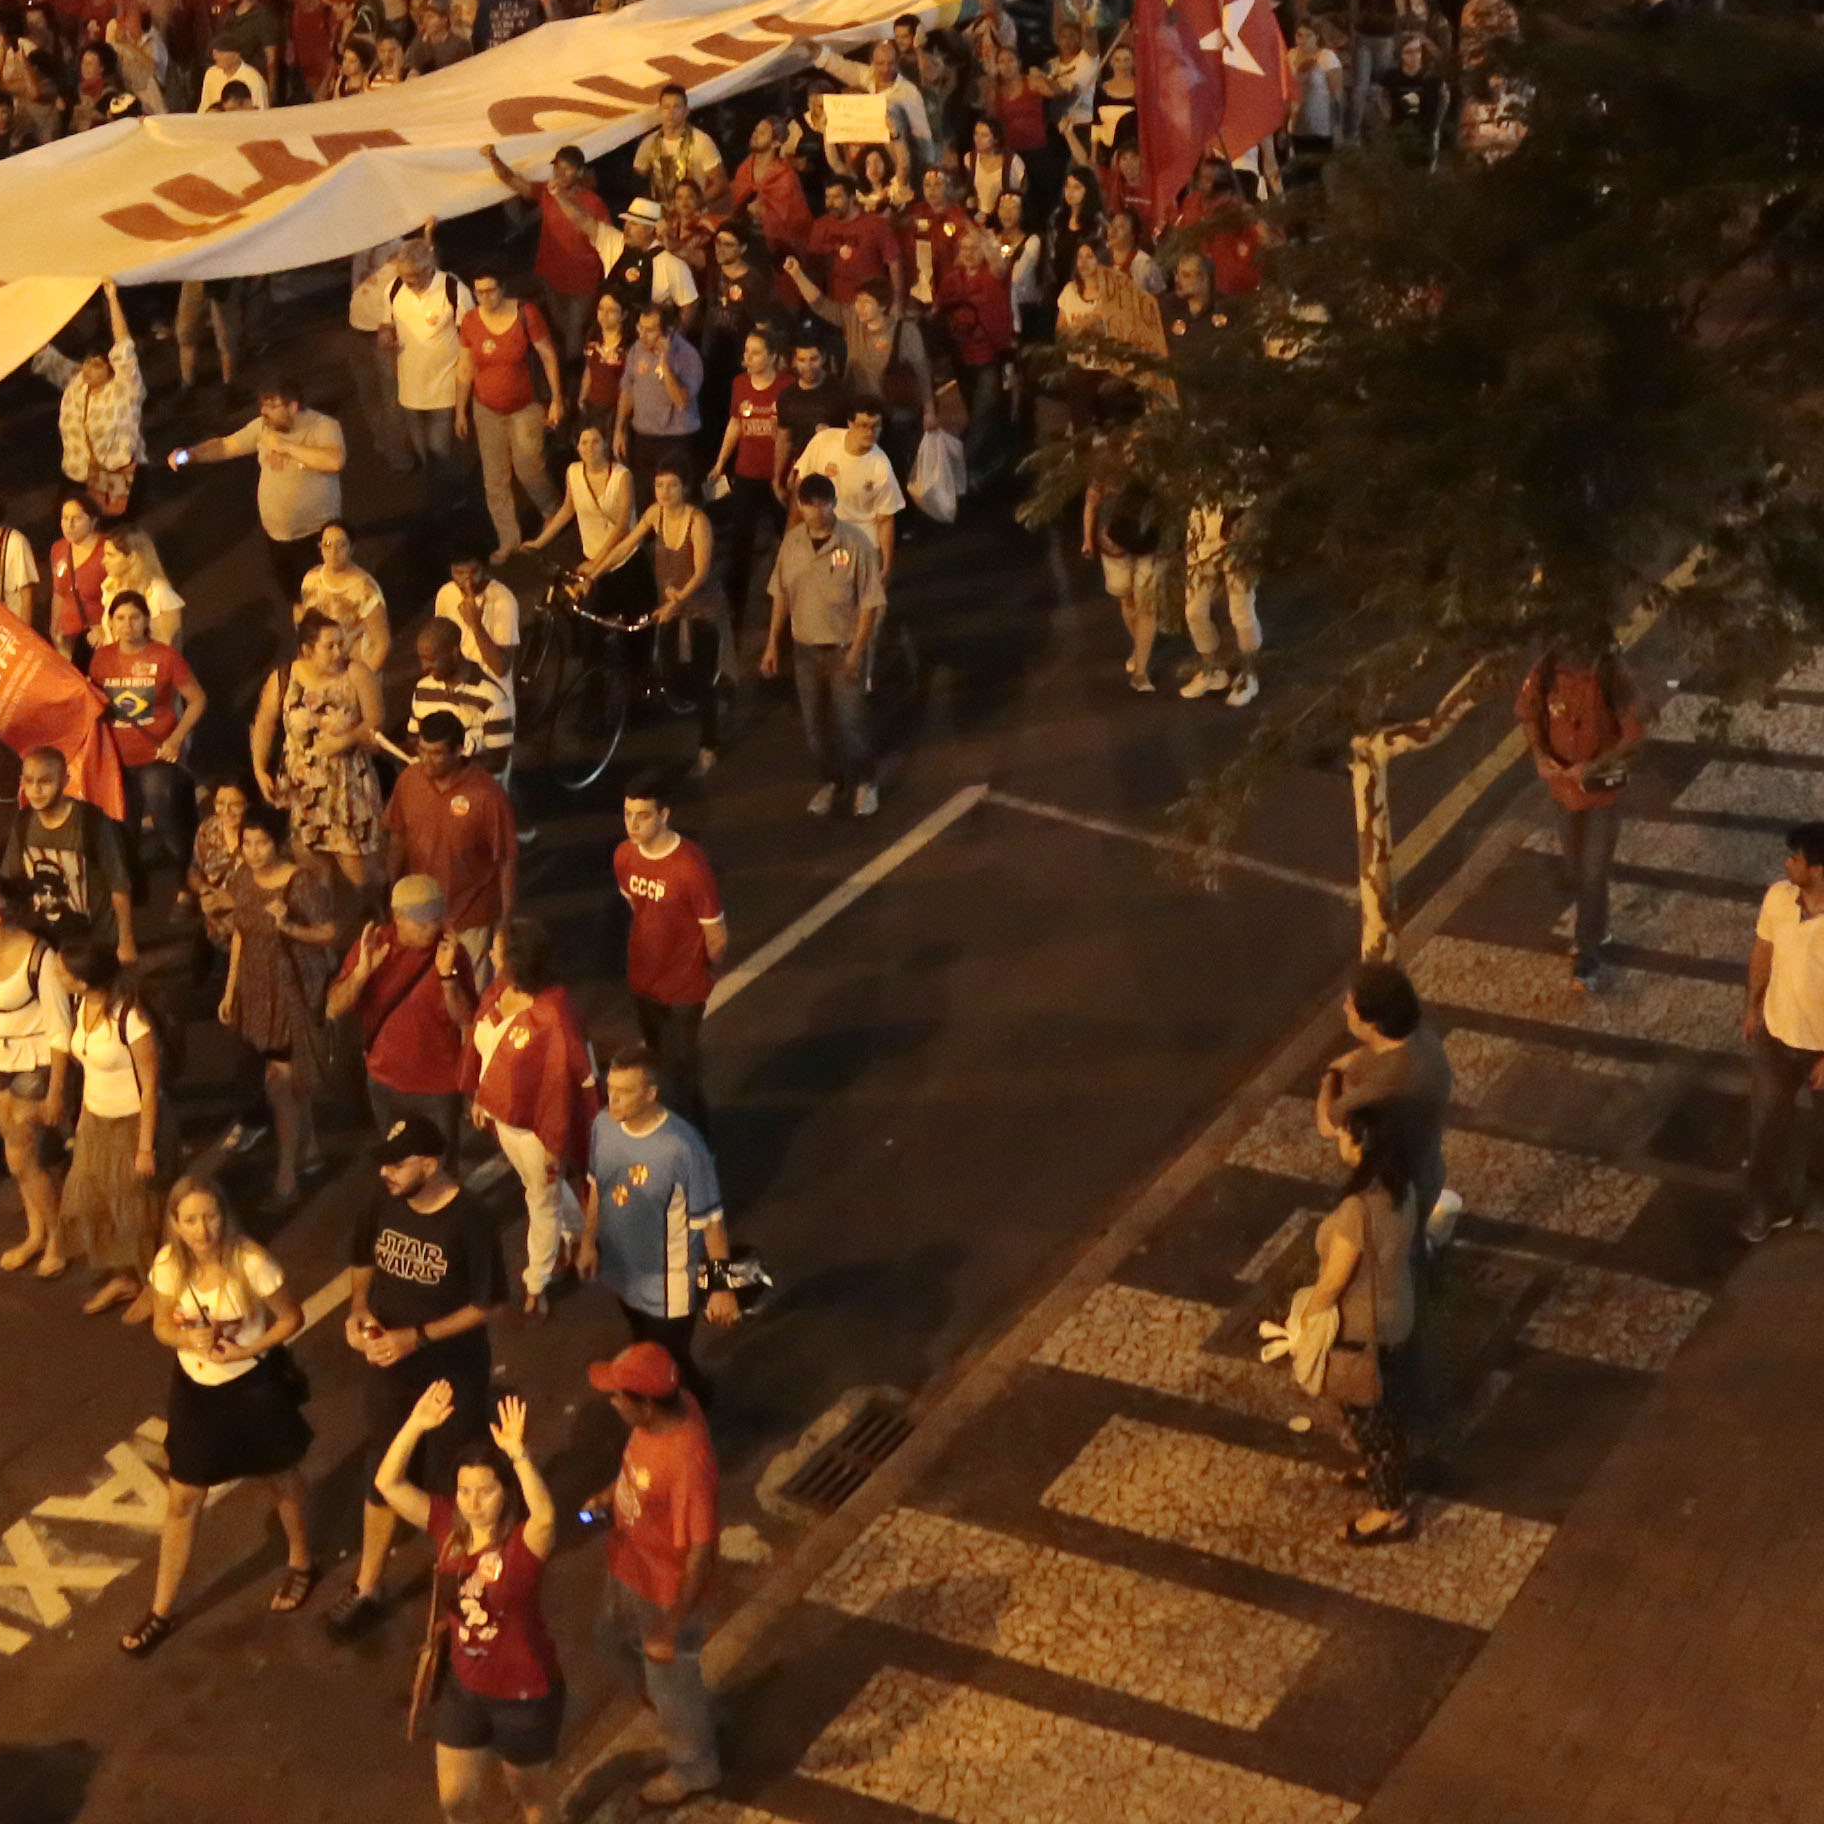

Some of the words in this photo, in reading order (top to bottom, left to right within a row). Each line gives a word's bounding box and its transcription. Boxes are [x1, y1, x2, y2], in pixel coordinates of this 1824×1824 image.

[629, 873, 665, 904] CCCP
[376, 1229, 446, 1267] STAR
[376, 1248, 447, 1284] WARS
